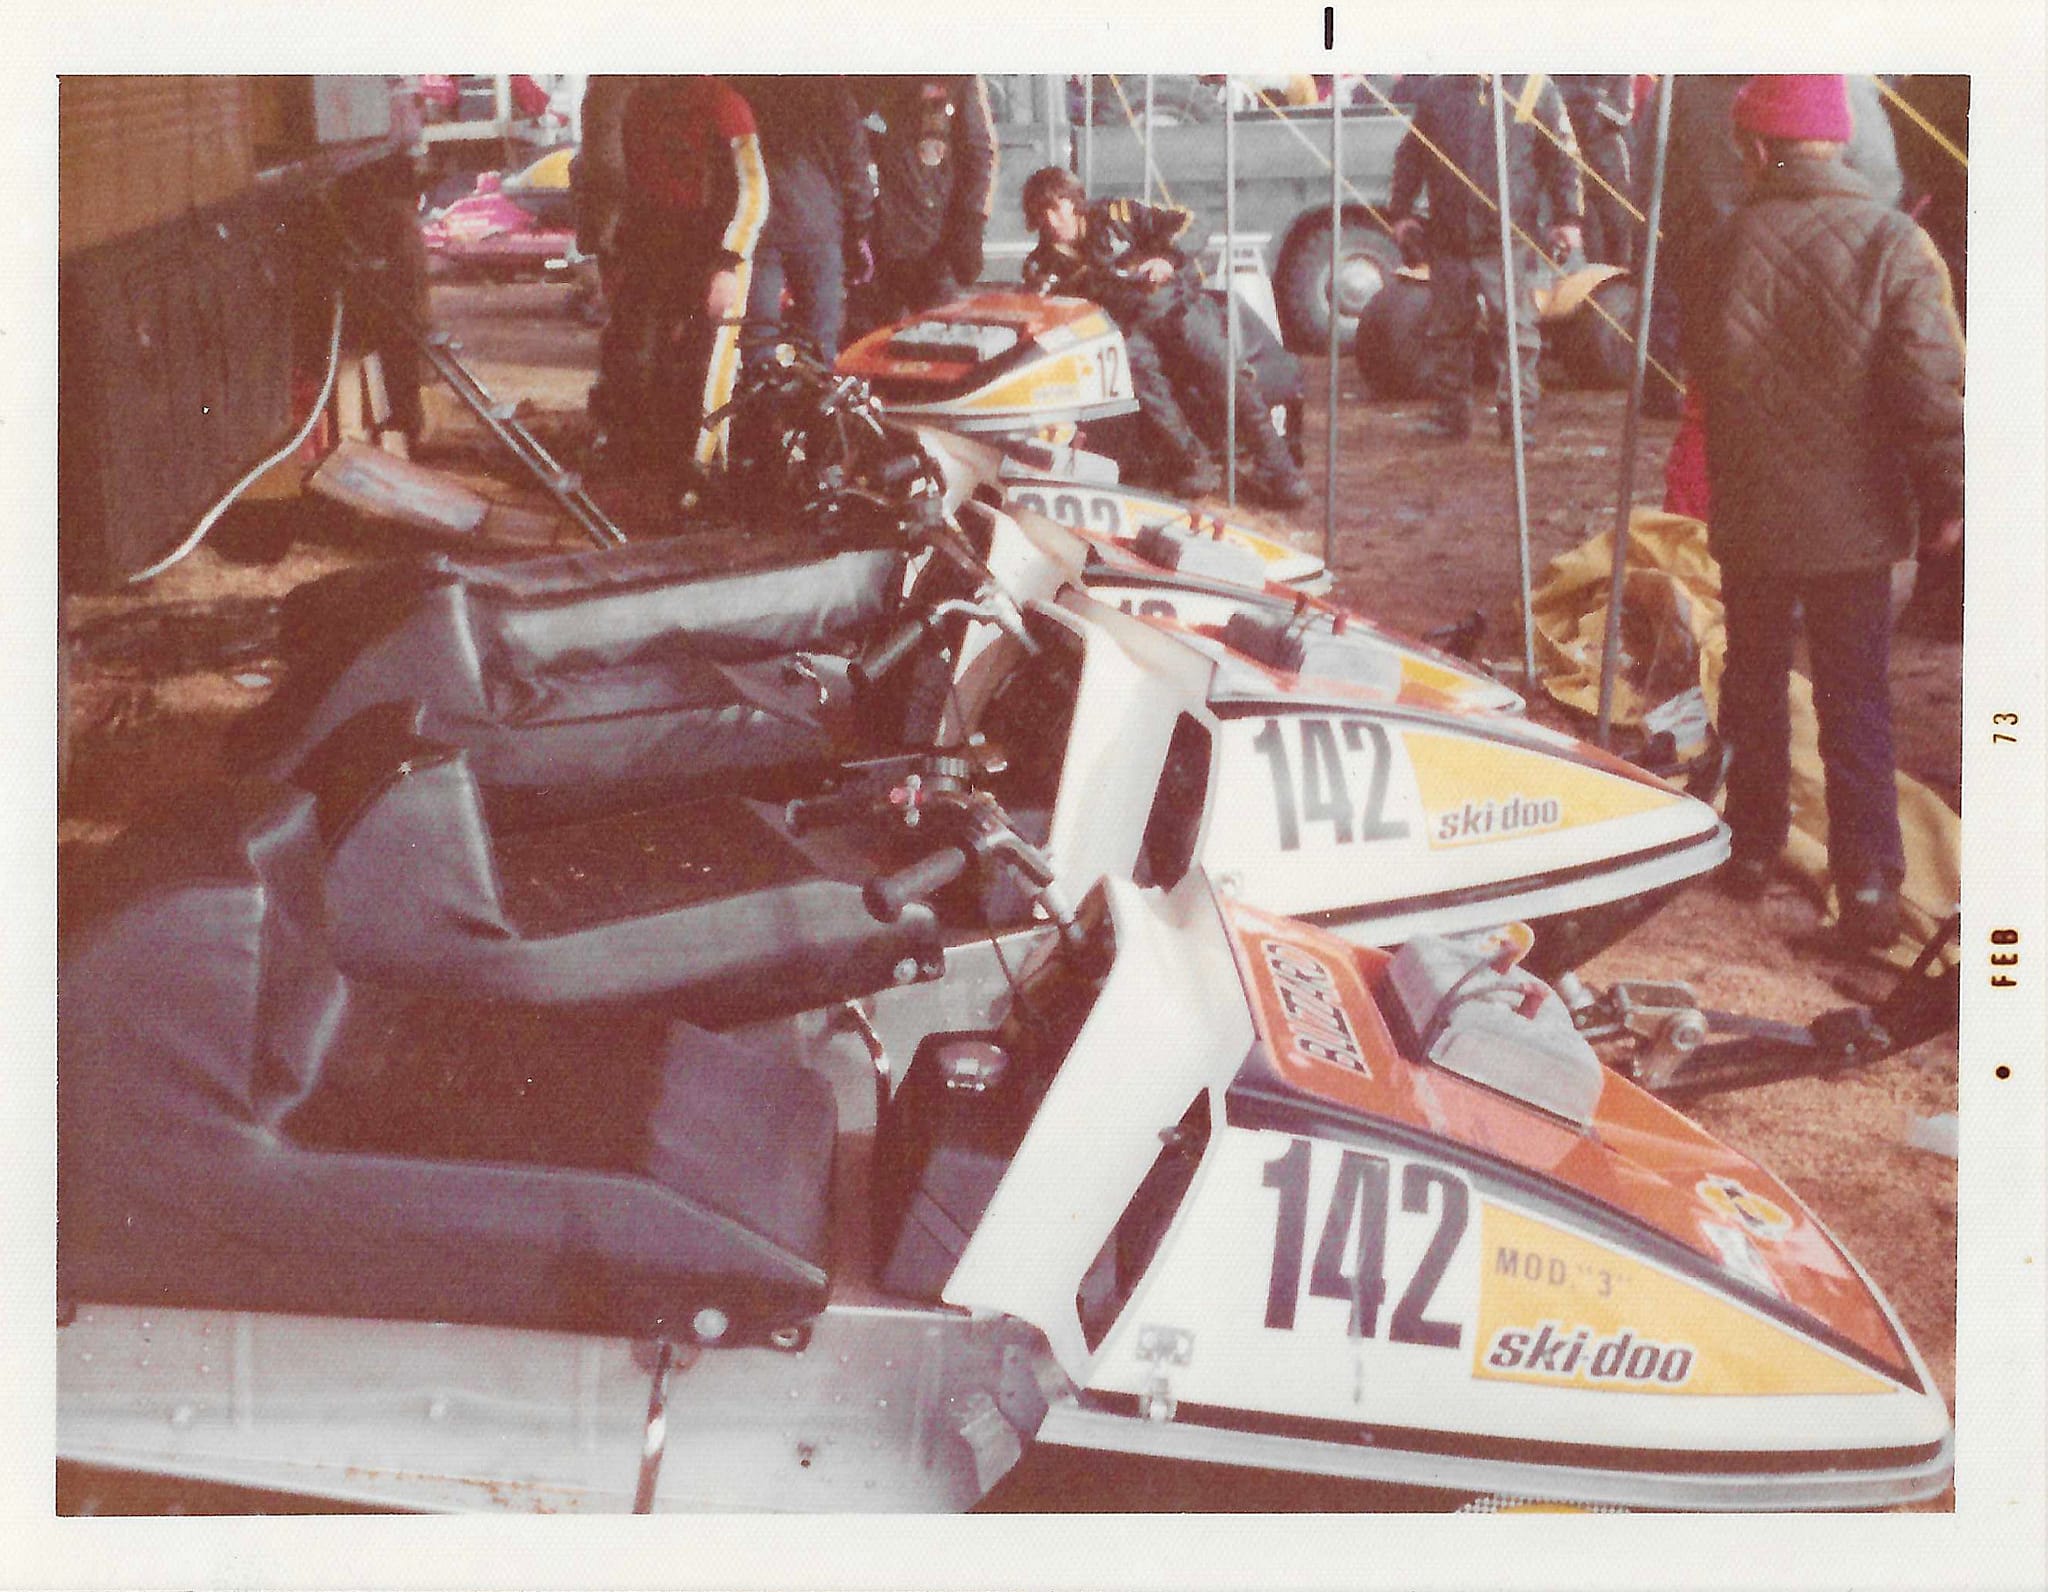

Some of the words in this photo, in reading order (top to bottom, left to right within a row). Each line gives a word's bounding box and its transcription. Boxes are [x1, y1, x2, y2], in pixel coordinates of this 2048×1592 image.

[1097, 346, 1119, 399] 12
[1253, 719, 1411, 851] 142
[1262, 1138, 1469, 1348] 142
